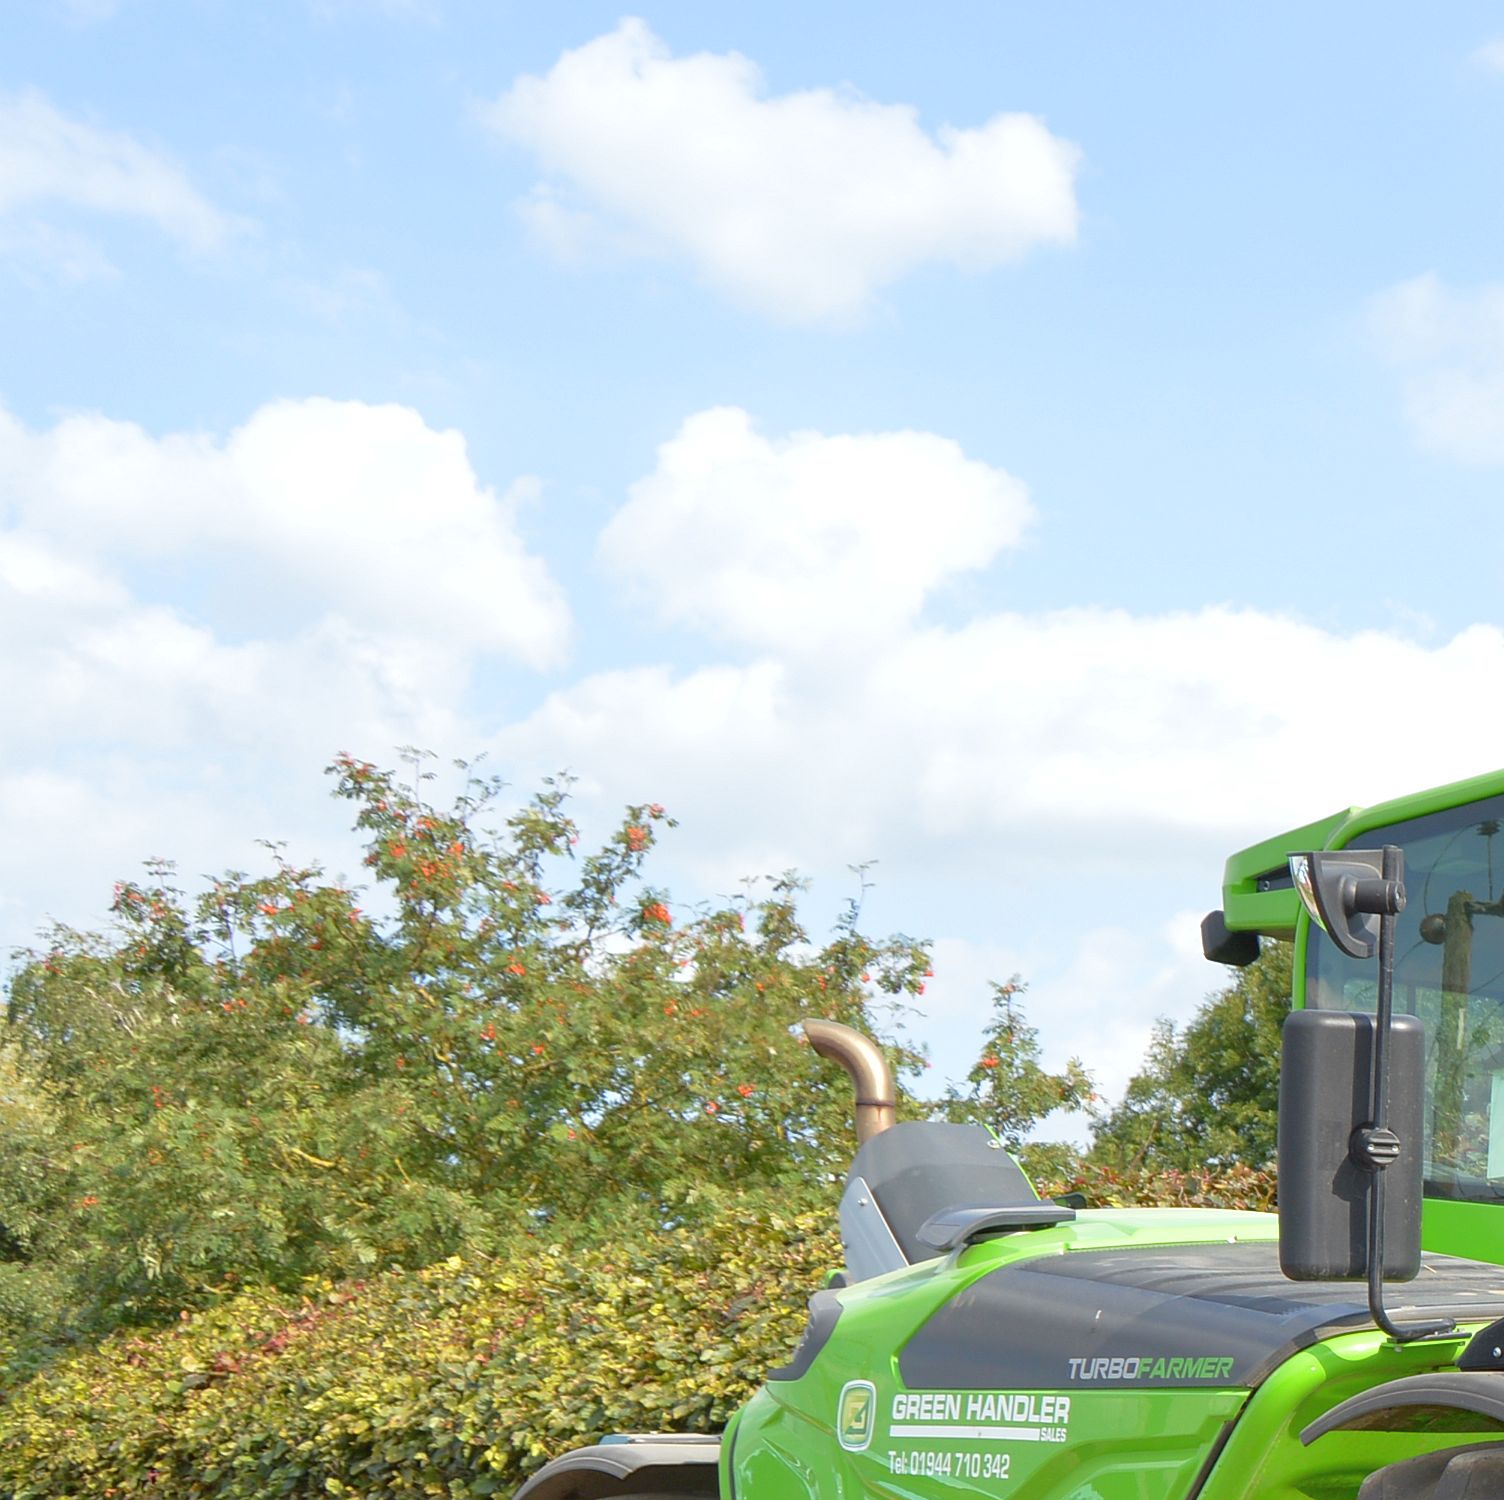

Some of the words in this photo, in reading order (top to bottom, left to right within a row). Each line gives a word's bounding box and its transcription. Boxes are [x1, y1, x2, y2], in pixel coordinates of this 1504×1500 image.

[1068, 1357, 1234, 1380] TURBOFARMER
[892, 1393, 961, 1421] GREEN
[966, 1394, 1071, 1424] HANDLER
[1040, 1428, 1068, 1442] SALES
[888, 1451, 908, 1475] Tel:
[910, 1451, 951, 1477] 01944
[955, 1453, 979, 1478] 710
[983, 1454, 1010, 1479] 342
